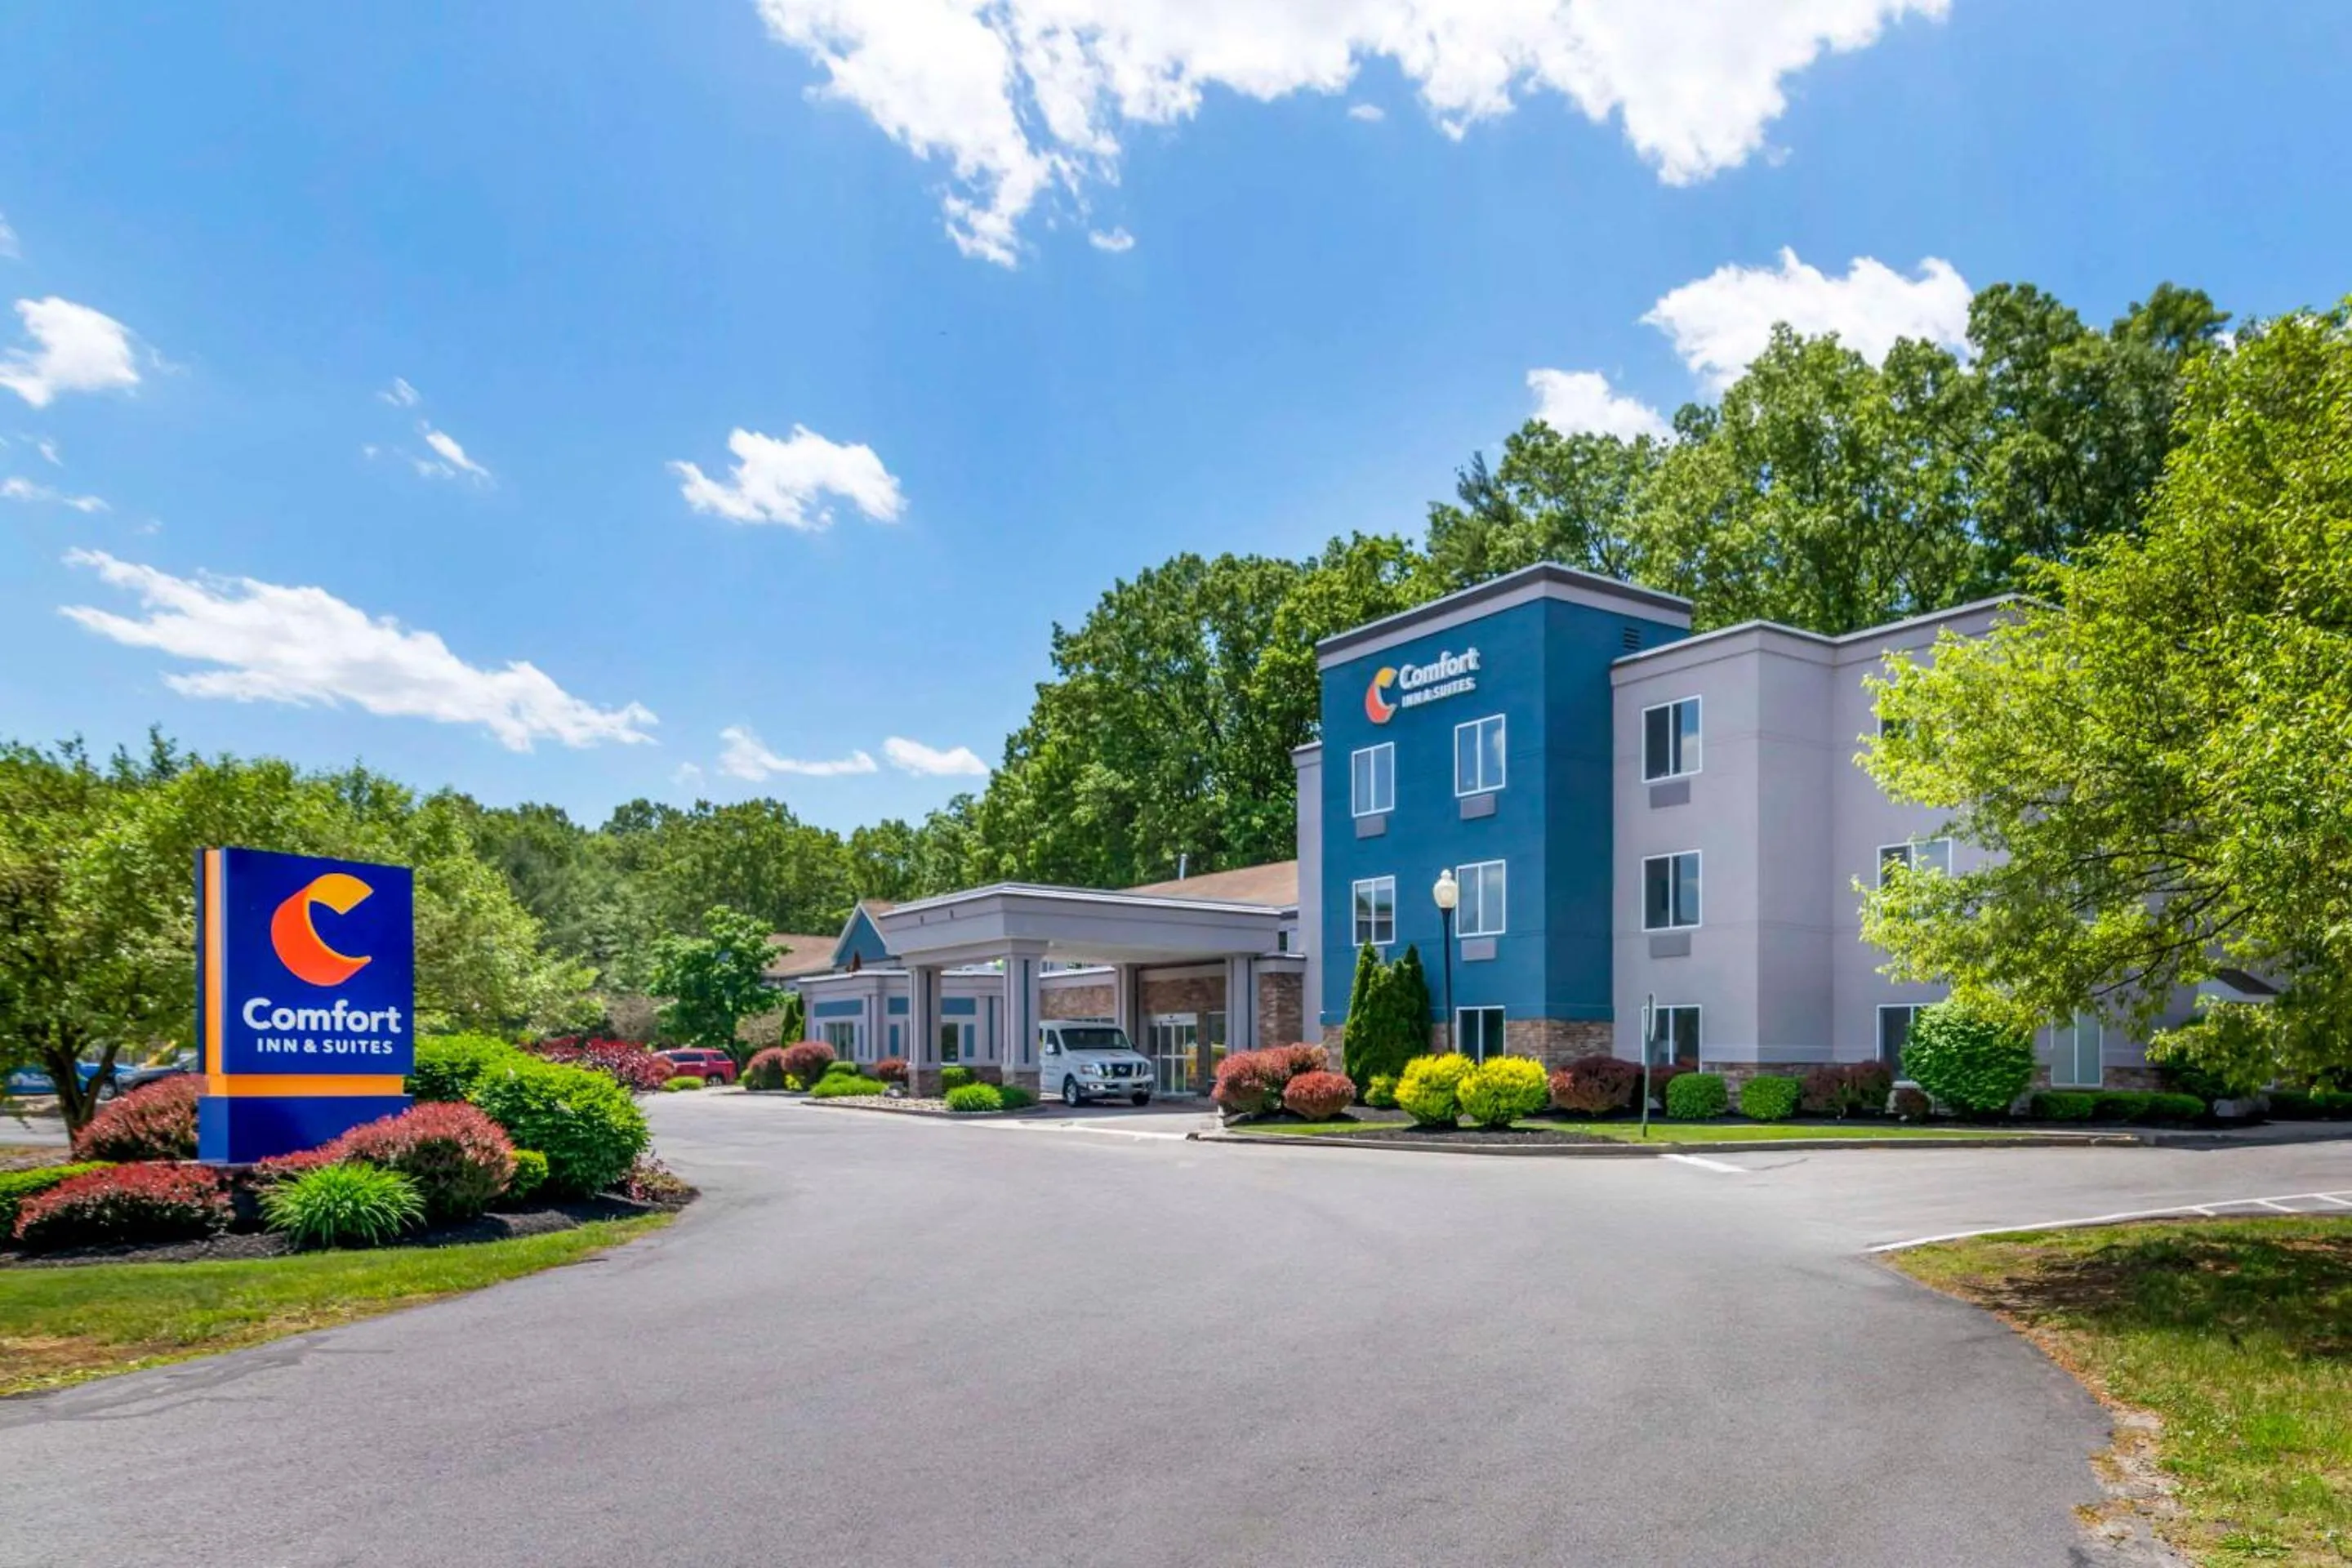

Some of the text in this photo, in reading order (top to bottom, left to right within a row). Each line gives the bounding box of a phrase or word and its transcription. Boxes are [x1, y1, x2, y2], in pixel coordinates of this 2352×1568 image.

[1399, 647, 1480, 689] Comfort
[243, 997, 402, 1034] Comfort
[257, 1038, 393, 1054] INN & SUITES
